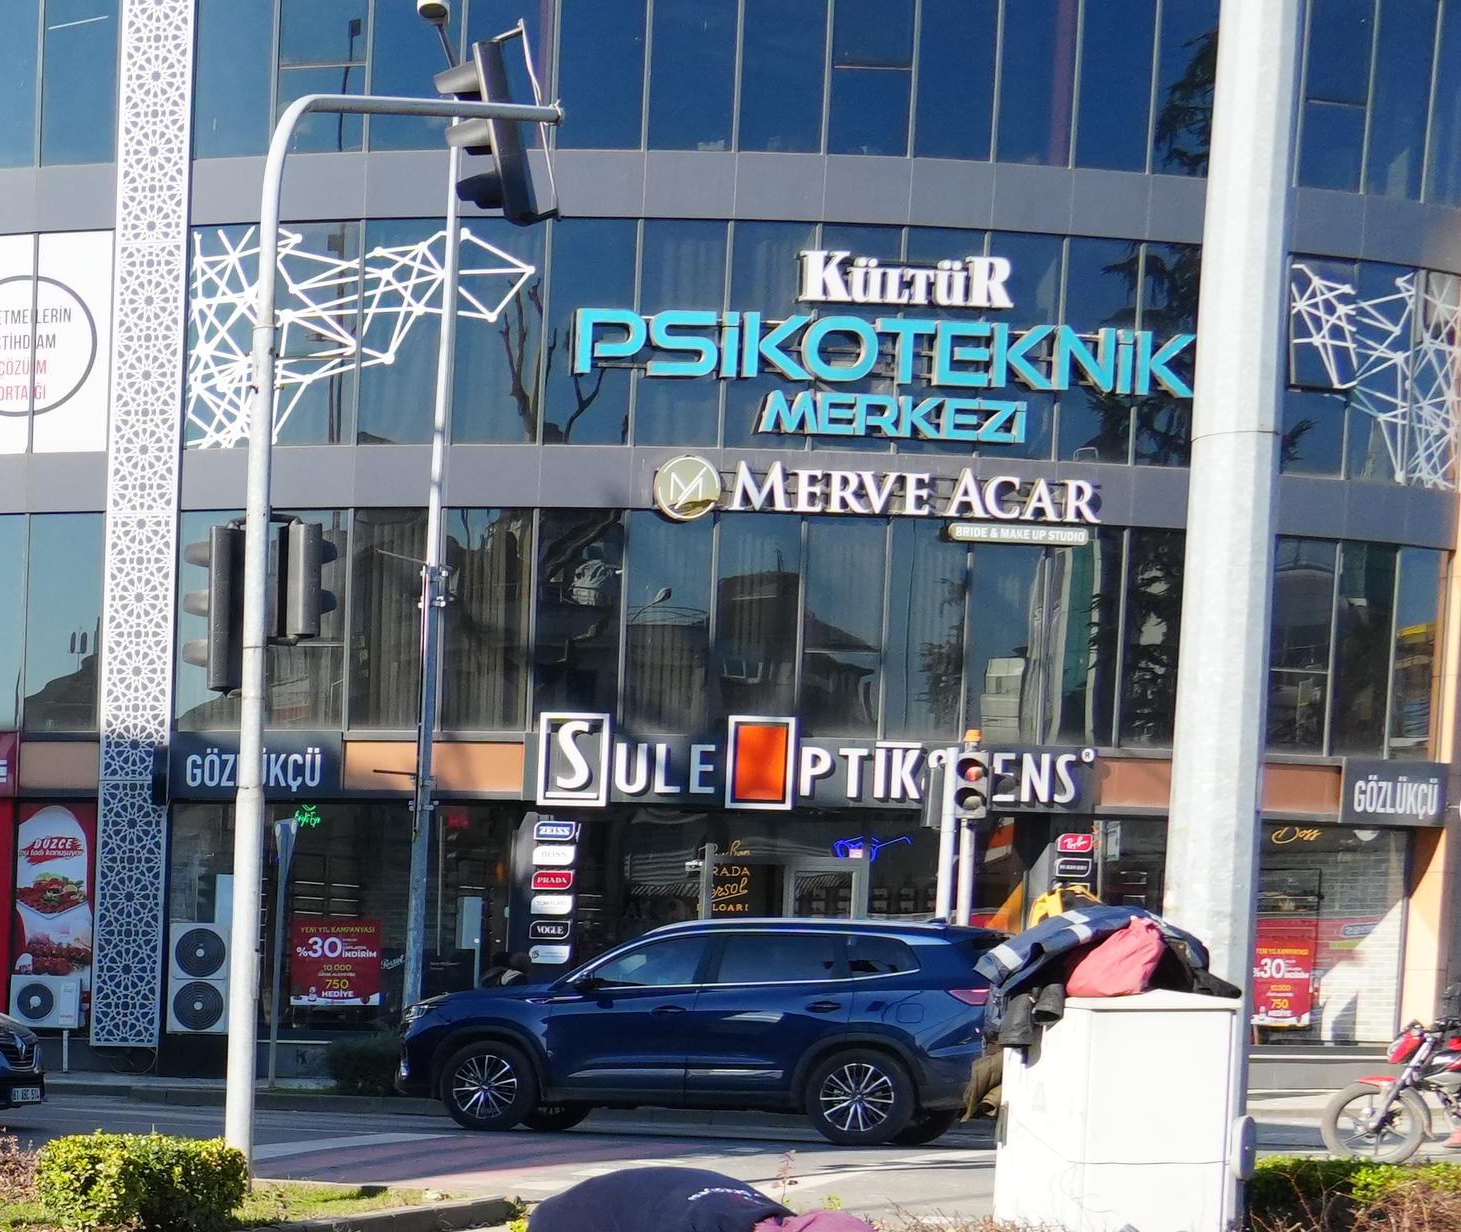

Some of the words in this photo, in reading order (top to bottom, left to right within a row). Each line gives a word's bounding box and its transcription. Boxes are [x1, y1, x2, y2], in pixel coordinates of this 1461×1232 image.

[727, 460, 931, 513] MERVE
[943, 467, 1103, 524] ACAR
[955, 525, 988, 539] BRIDE
[989, 527, 998, 539] &
[999, 527, 1032, 541] MAKE
[1032, 528, 1047, 541] UP
[1048, 529, 1087, 543] STUDIO
[990, 751, 1077, 804] ENS
[1353, 775, 1439, 820] GÖZLÜKÇÜ
[538, 826, 571, 836] ZEISS
[33, 836, 74, 850] DÜZCE
[712, 865, 751, 877] RADA
[536, 876, 568, 884] PRADA
[331, 926, 376, 934] KAMPANYASI
[536, 925, 564, 935] VOGUE
[296, 936, 343, 959] %30
[342, 949, 377, 958] İNDİRİM
[324, 979, 349, 989] 750
[321, 989, 354, 998] HEDİYE
[1270, 998, 1289, 1010] 750
